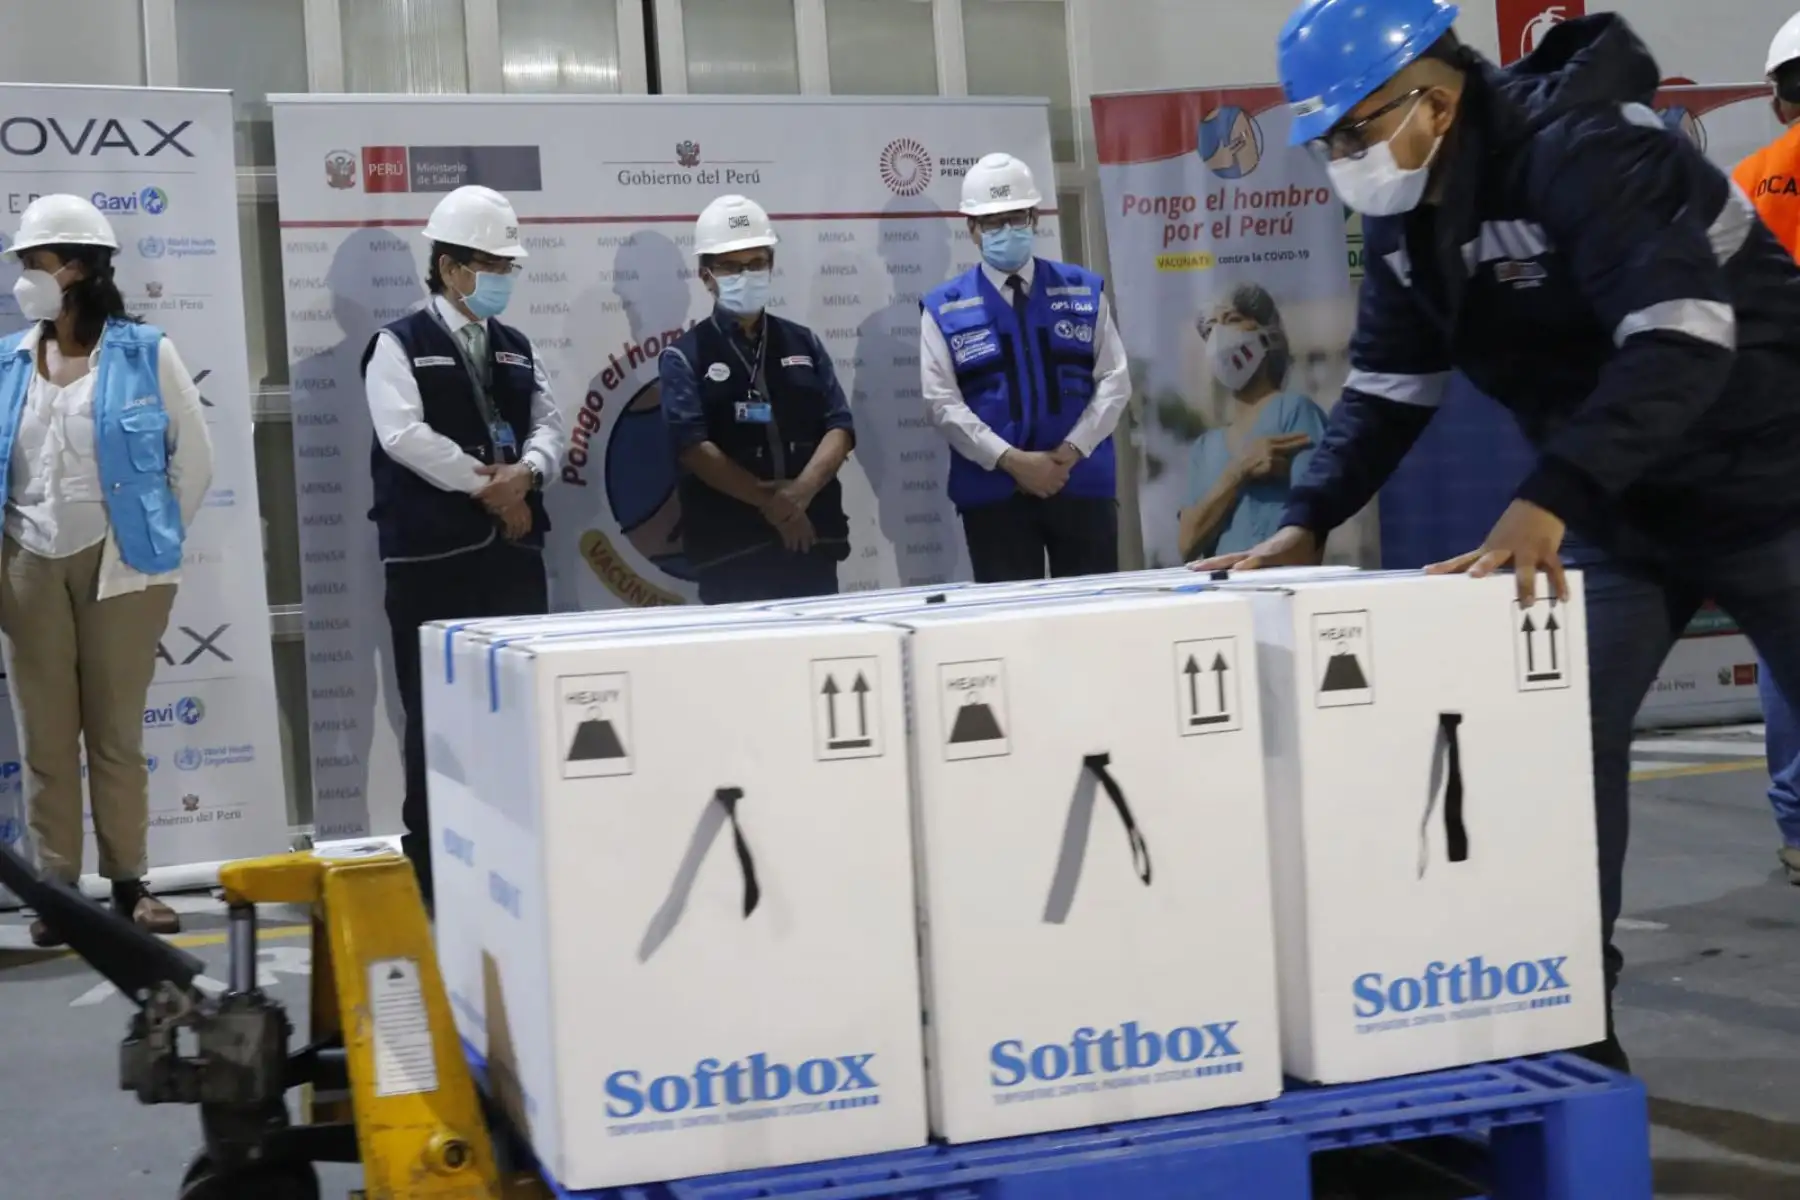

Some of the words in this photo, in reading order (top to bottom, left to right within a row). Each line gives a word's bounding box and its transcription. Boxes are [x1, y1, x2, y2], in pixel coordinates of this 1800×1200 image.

[368, 161, 404, 177] PERÚ
[416, 162, 468, 173] Ministerio
[940, 157, 981, 166] BICENT
[417, 174, 431, 185] de
[432, 174, 460, 185] Salud
[617, 169, 692, 186] Gobierno
[696, 169, 721, 185] del
[725, 168, 761, 184] Perú
[92, 192, 138, 210] Gavi
[1122, 193, 1196, 220] Pongo
[1206, 187, 1225, 211] el
[1233, 184, 1330, 211] hombro
[818, 231, 855, 243] MINSA
[884, 231, 920, 243] MINSA
[1163, 221, 1204, 248] por
[1211, 215, 1230, 239] el
[1240, 212, 1294, 237] Perú
[525, 236, 566, 248] MINSA
[1218, 252, 1250, 265] contra
[1252, 252, 1262, 262] la
[1265, 250, 1310, 261] COVID-19
[820, 264, 858, 276] MINSA
[886, 263, 922, 275] MINSA
[372, 276, 414, 288] MINSA
[528, 271, 569, 283] MINSA
[823, 294, 861, 306] MINSA
[530, 301, 570, 315] MINSA
[561, 389, 604, 487] Pongo
[601, 352, 626, 391] el
[1318, 626, 1363, 641] HEAVY
[947, 675, 998, 691] HEAVY
[564, 689, 620, 705] HEAVY
[1352, 955, 1571, 1019] Softbox
[989, 1020, 1242, 1087] Softbox
[604, 1051, 881, 1119] Softbox
